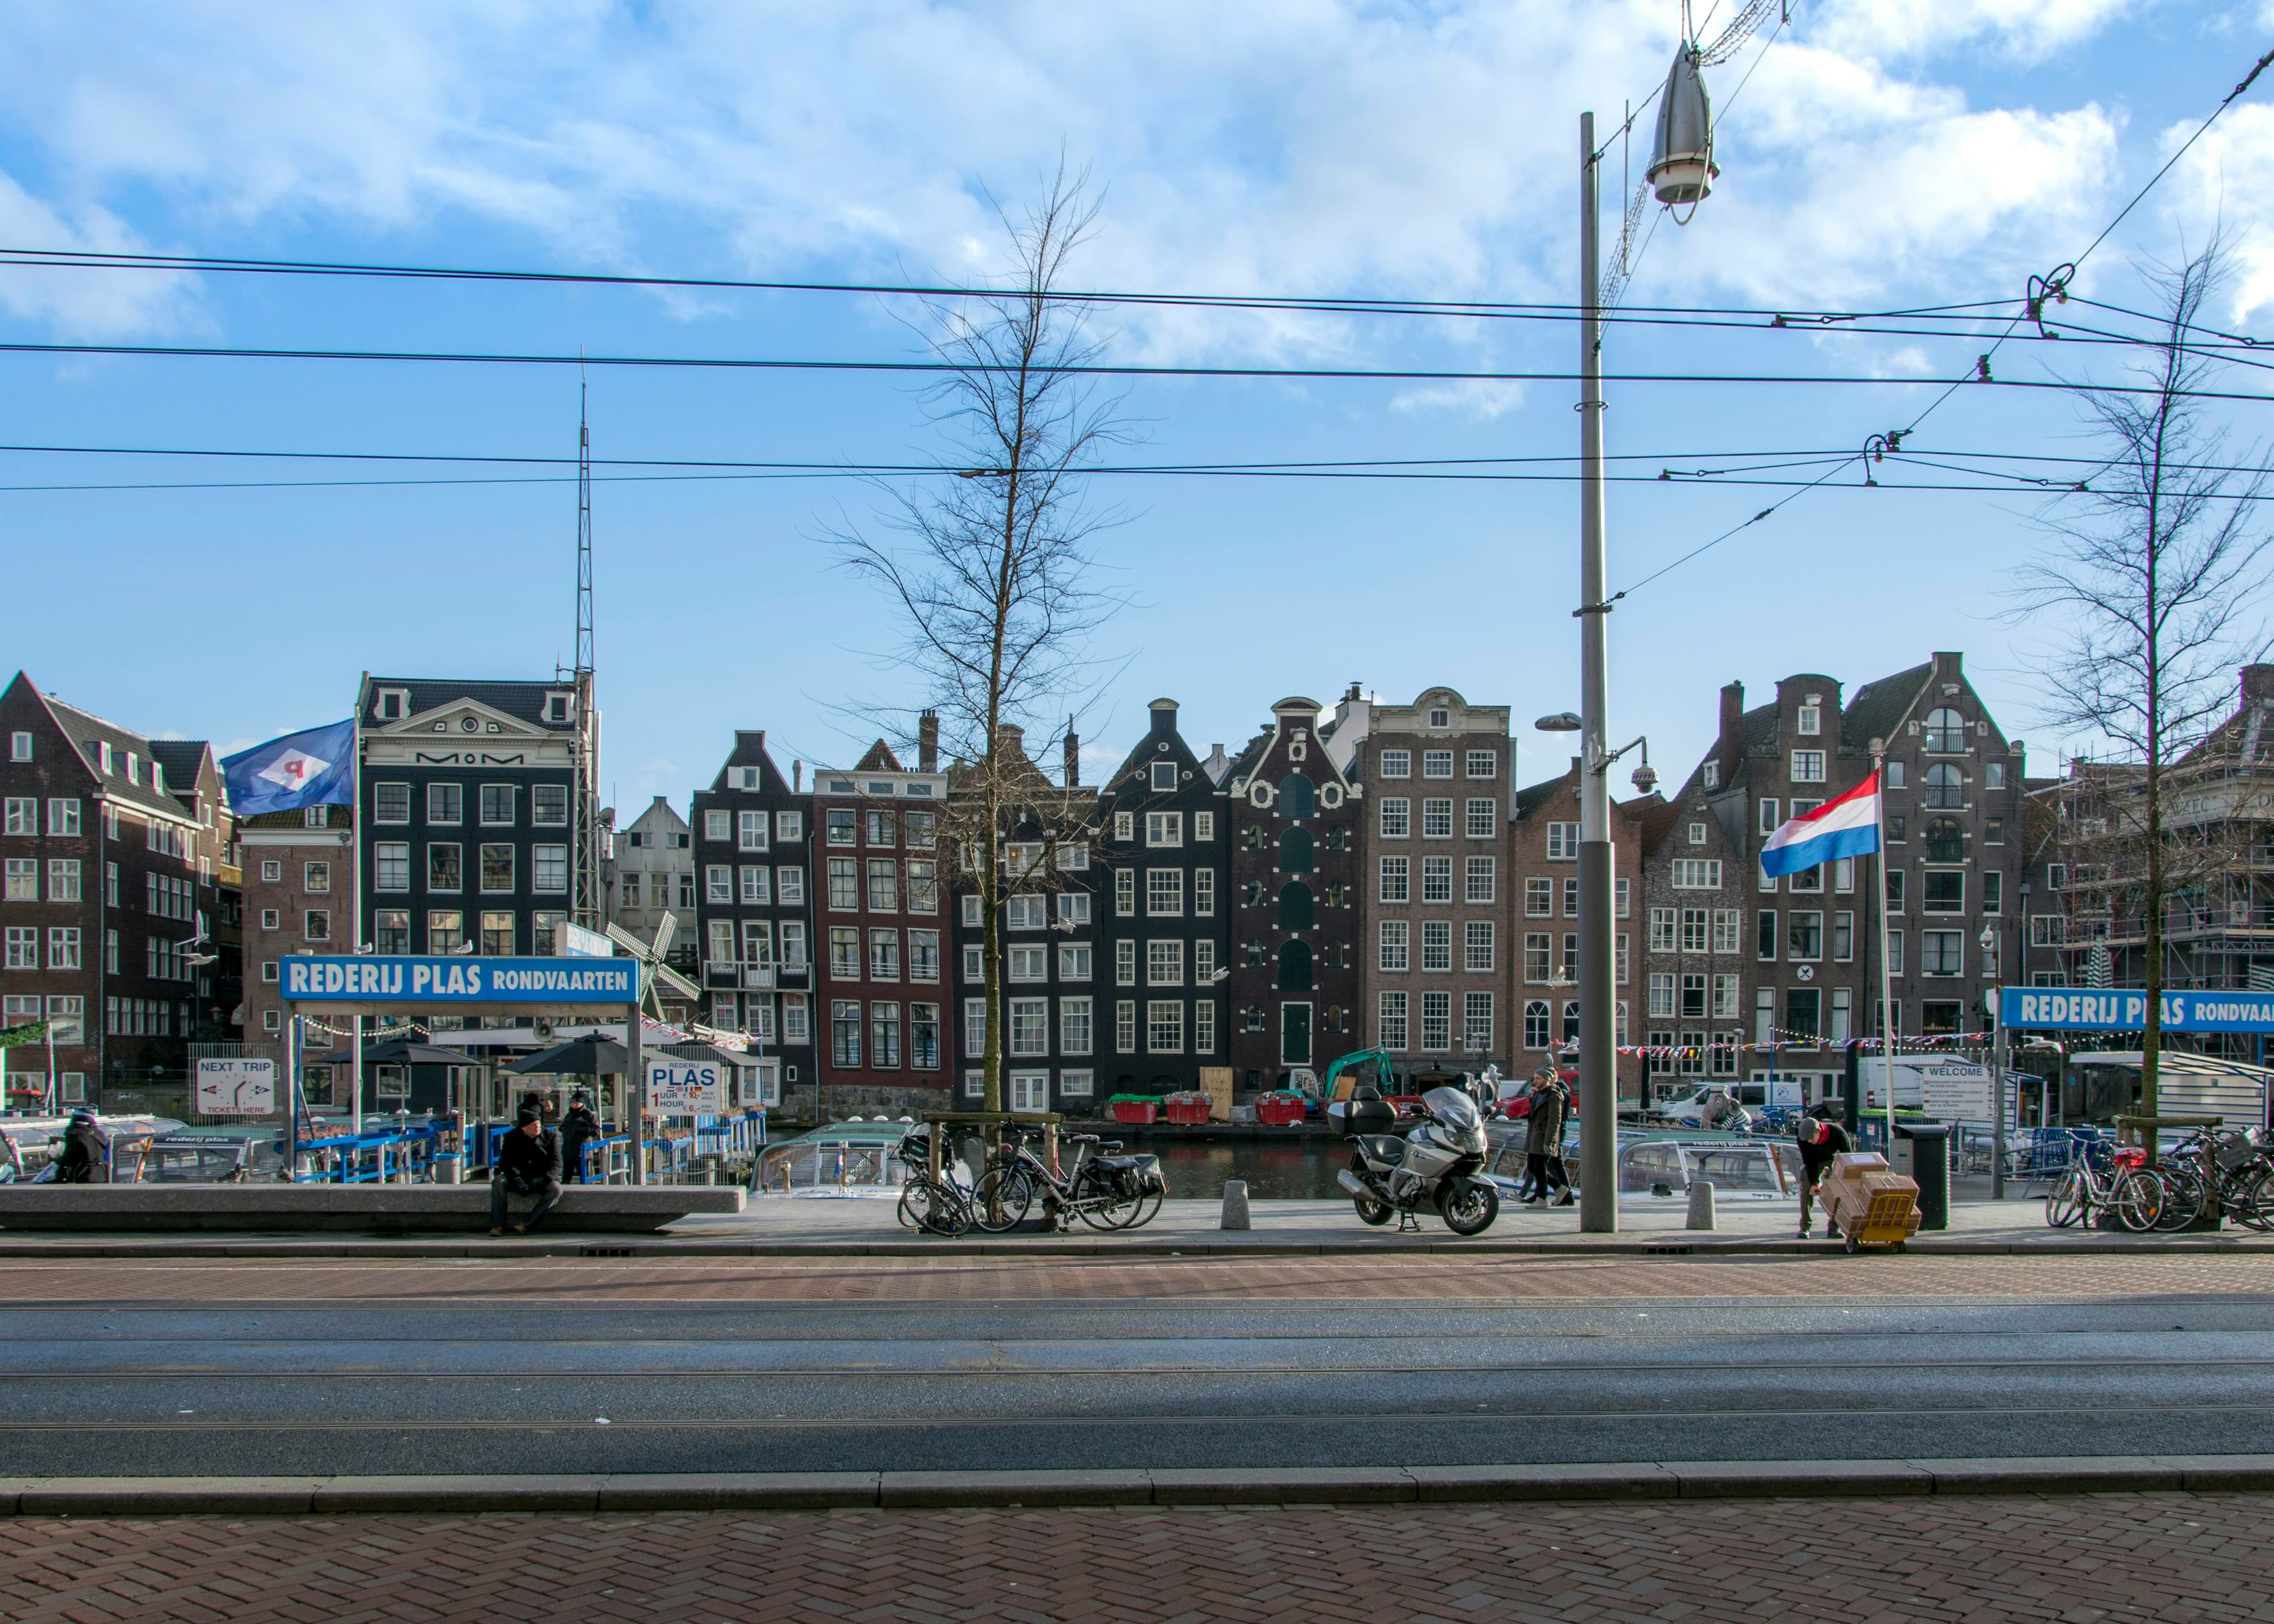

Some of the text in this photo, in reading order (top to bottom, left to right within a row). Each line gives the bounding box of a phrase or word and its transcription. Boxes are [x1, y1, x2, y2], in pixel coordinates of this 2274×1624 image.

[290, 963, 628, 995] REDERIJ PLAS RONDVAARTEN
[2021, 995, 2118, 1024] REDERIJ
[2195, 1003, 2274, 1022] RONDVAA
[201, 1062, 271, 1072] NEXT TRIP
[1929, 1067, 1983, 1076] WELCOME
[653, 1068, 715, 1086] PLAS
[651, 1092, 659, 1107] 1
